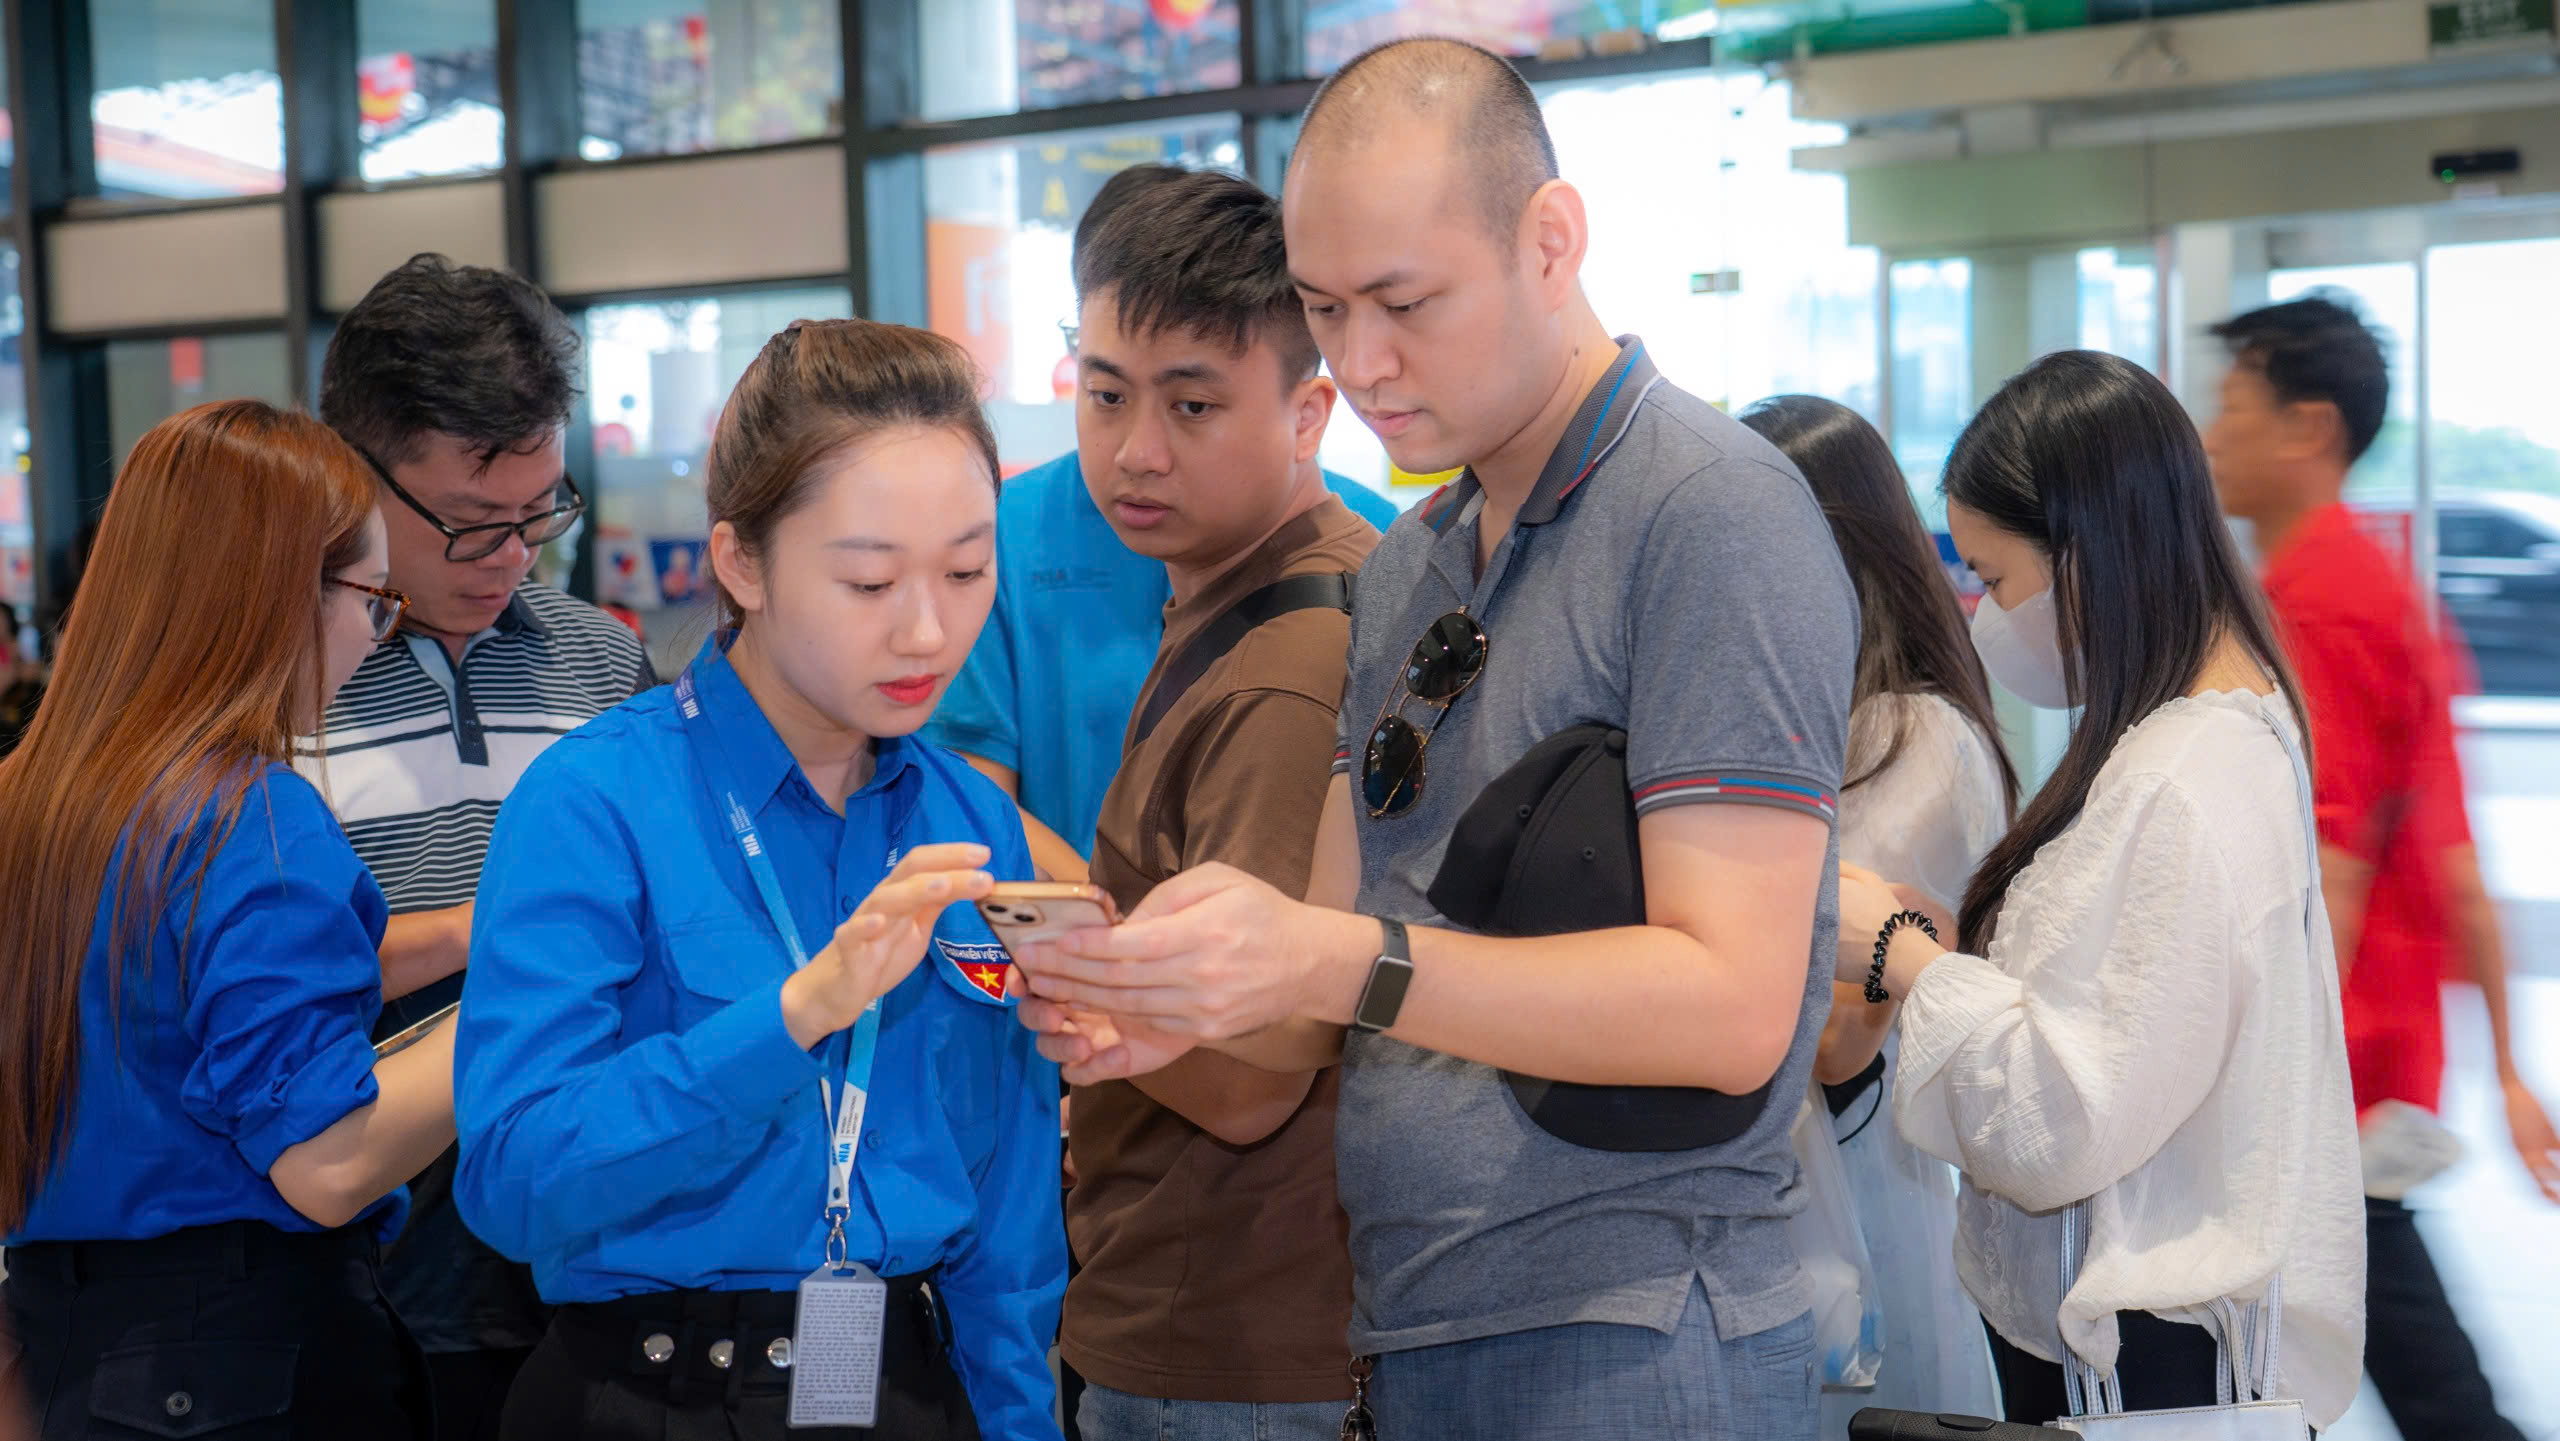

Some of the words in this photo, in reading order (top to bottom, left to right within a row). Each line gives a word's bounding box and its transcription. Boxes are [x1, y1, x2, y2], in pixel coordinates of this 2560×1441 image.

[682, 698, 700, 719] NIA
[742, 833, 762, 857] NIA
[886, 847, 899, 867] NIA
[981, 947, 1000, 962] VIỆT
[839, 1143, 850, 1163] NIA
